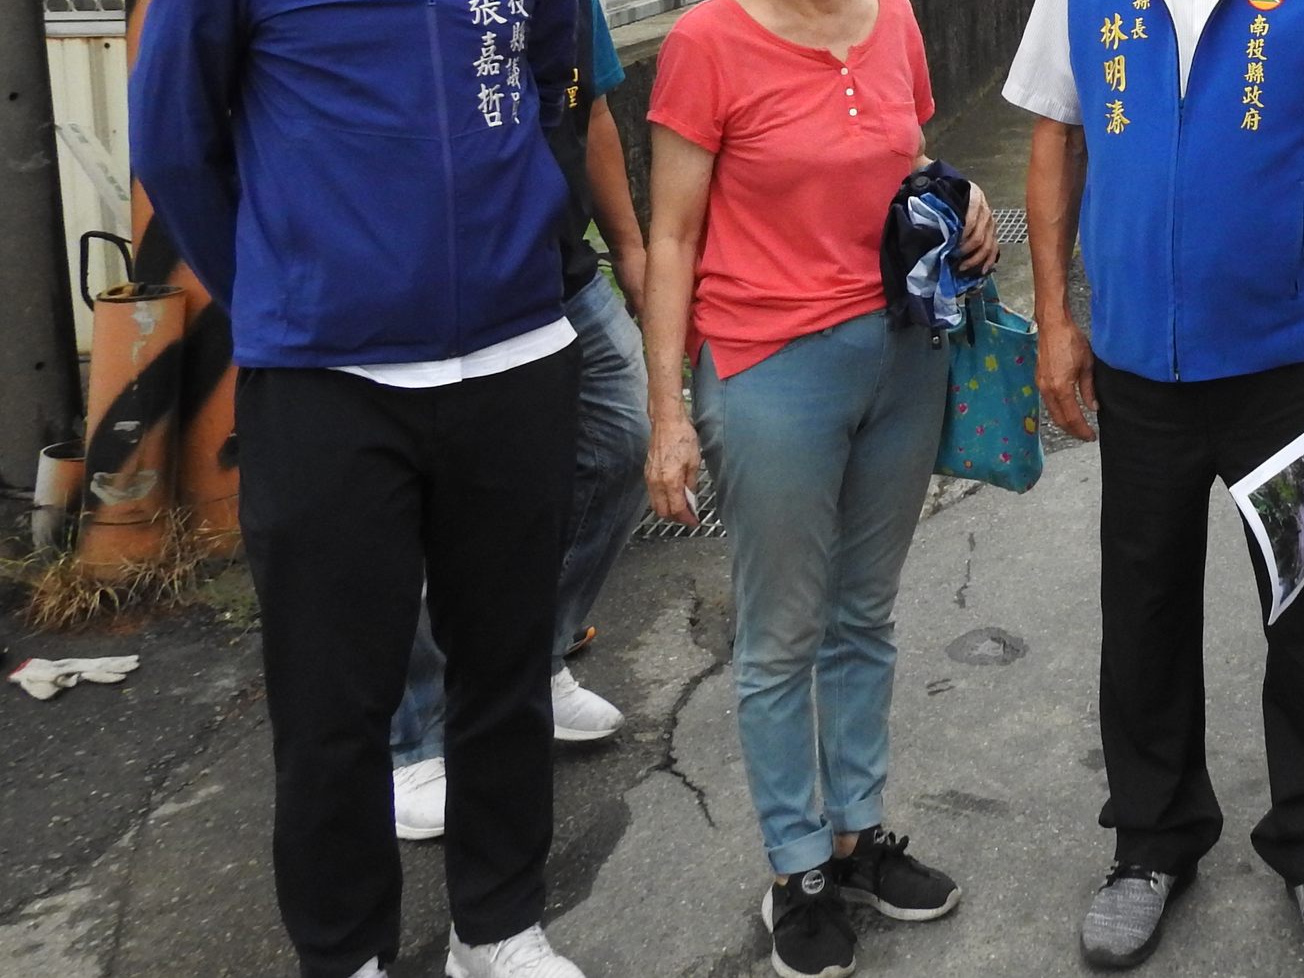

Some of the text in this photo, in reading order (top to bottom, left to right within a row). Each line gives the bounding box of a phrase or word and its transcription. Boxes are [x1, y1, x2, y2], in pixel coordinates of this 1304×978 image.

[1100, 13, 1131, 134] 林明溱
[1240, 14, 1270, 131] 南投縣政府
